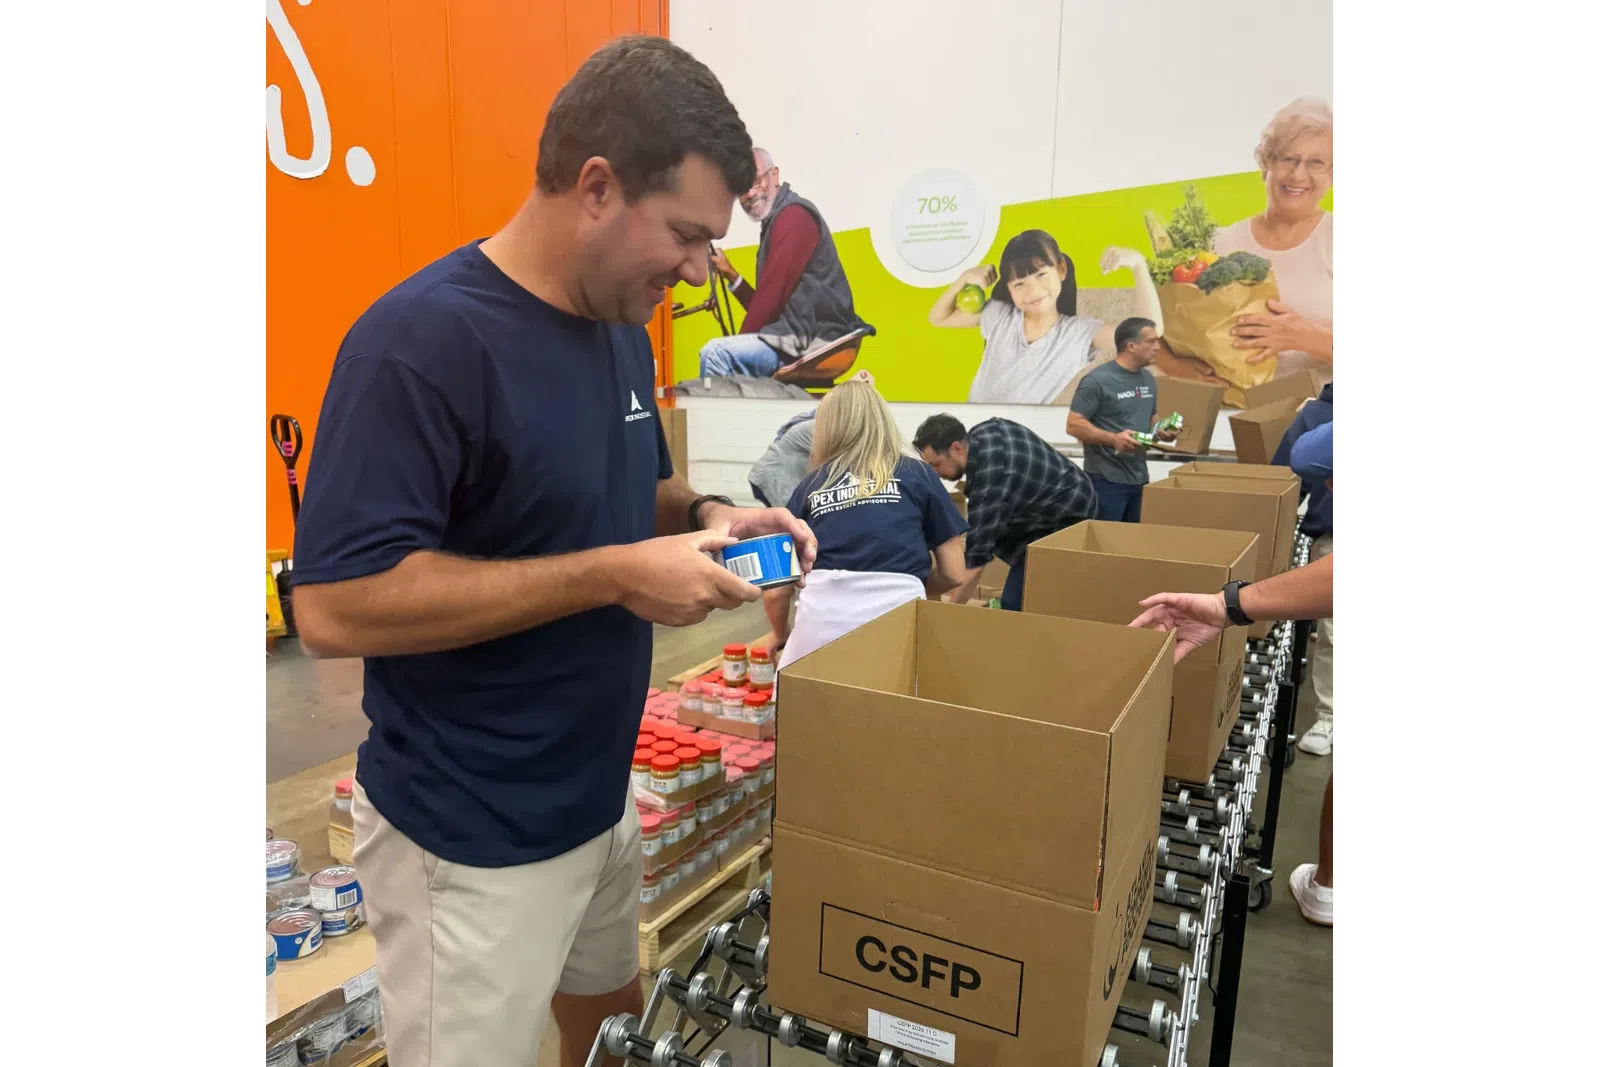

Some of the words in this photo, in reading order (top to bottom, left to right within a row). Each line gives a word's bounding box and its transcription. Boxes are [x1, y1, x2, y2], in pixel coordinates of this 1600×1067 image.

[917, 194, 957, 214] 70%
[837, 482, 900, 502] INDSTIAL
[820, 507, 834, 515] REAL
[855, 935, 981, 998] CSFP
